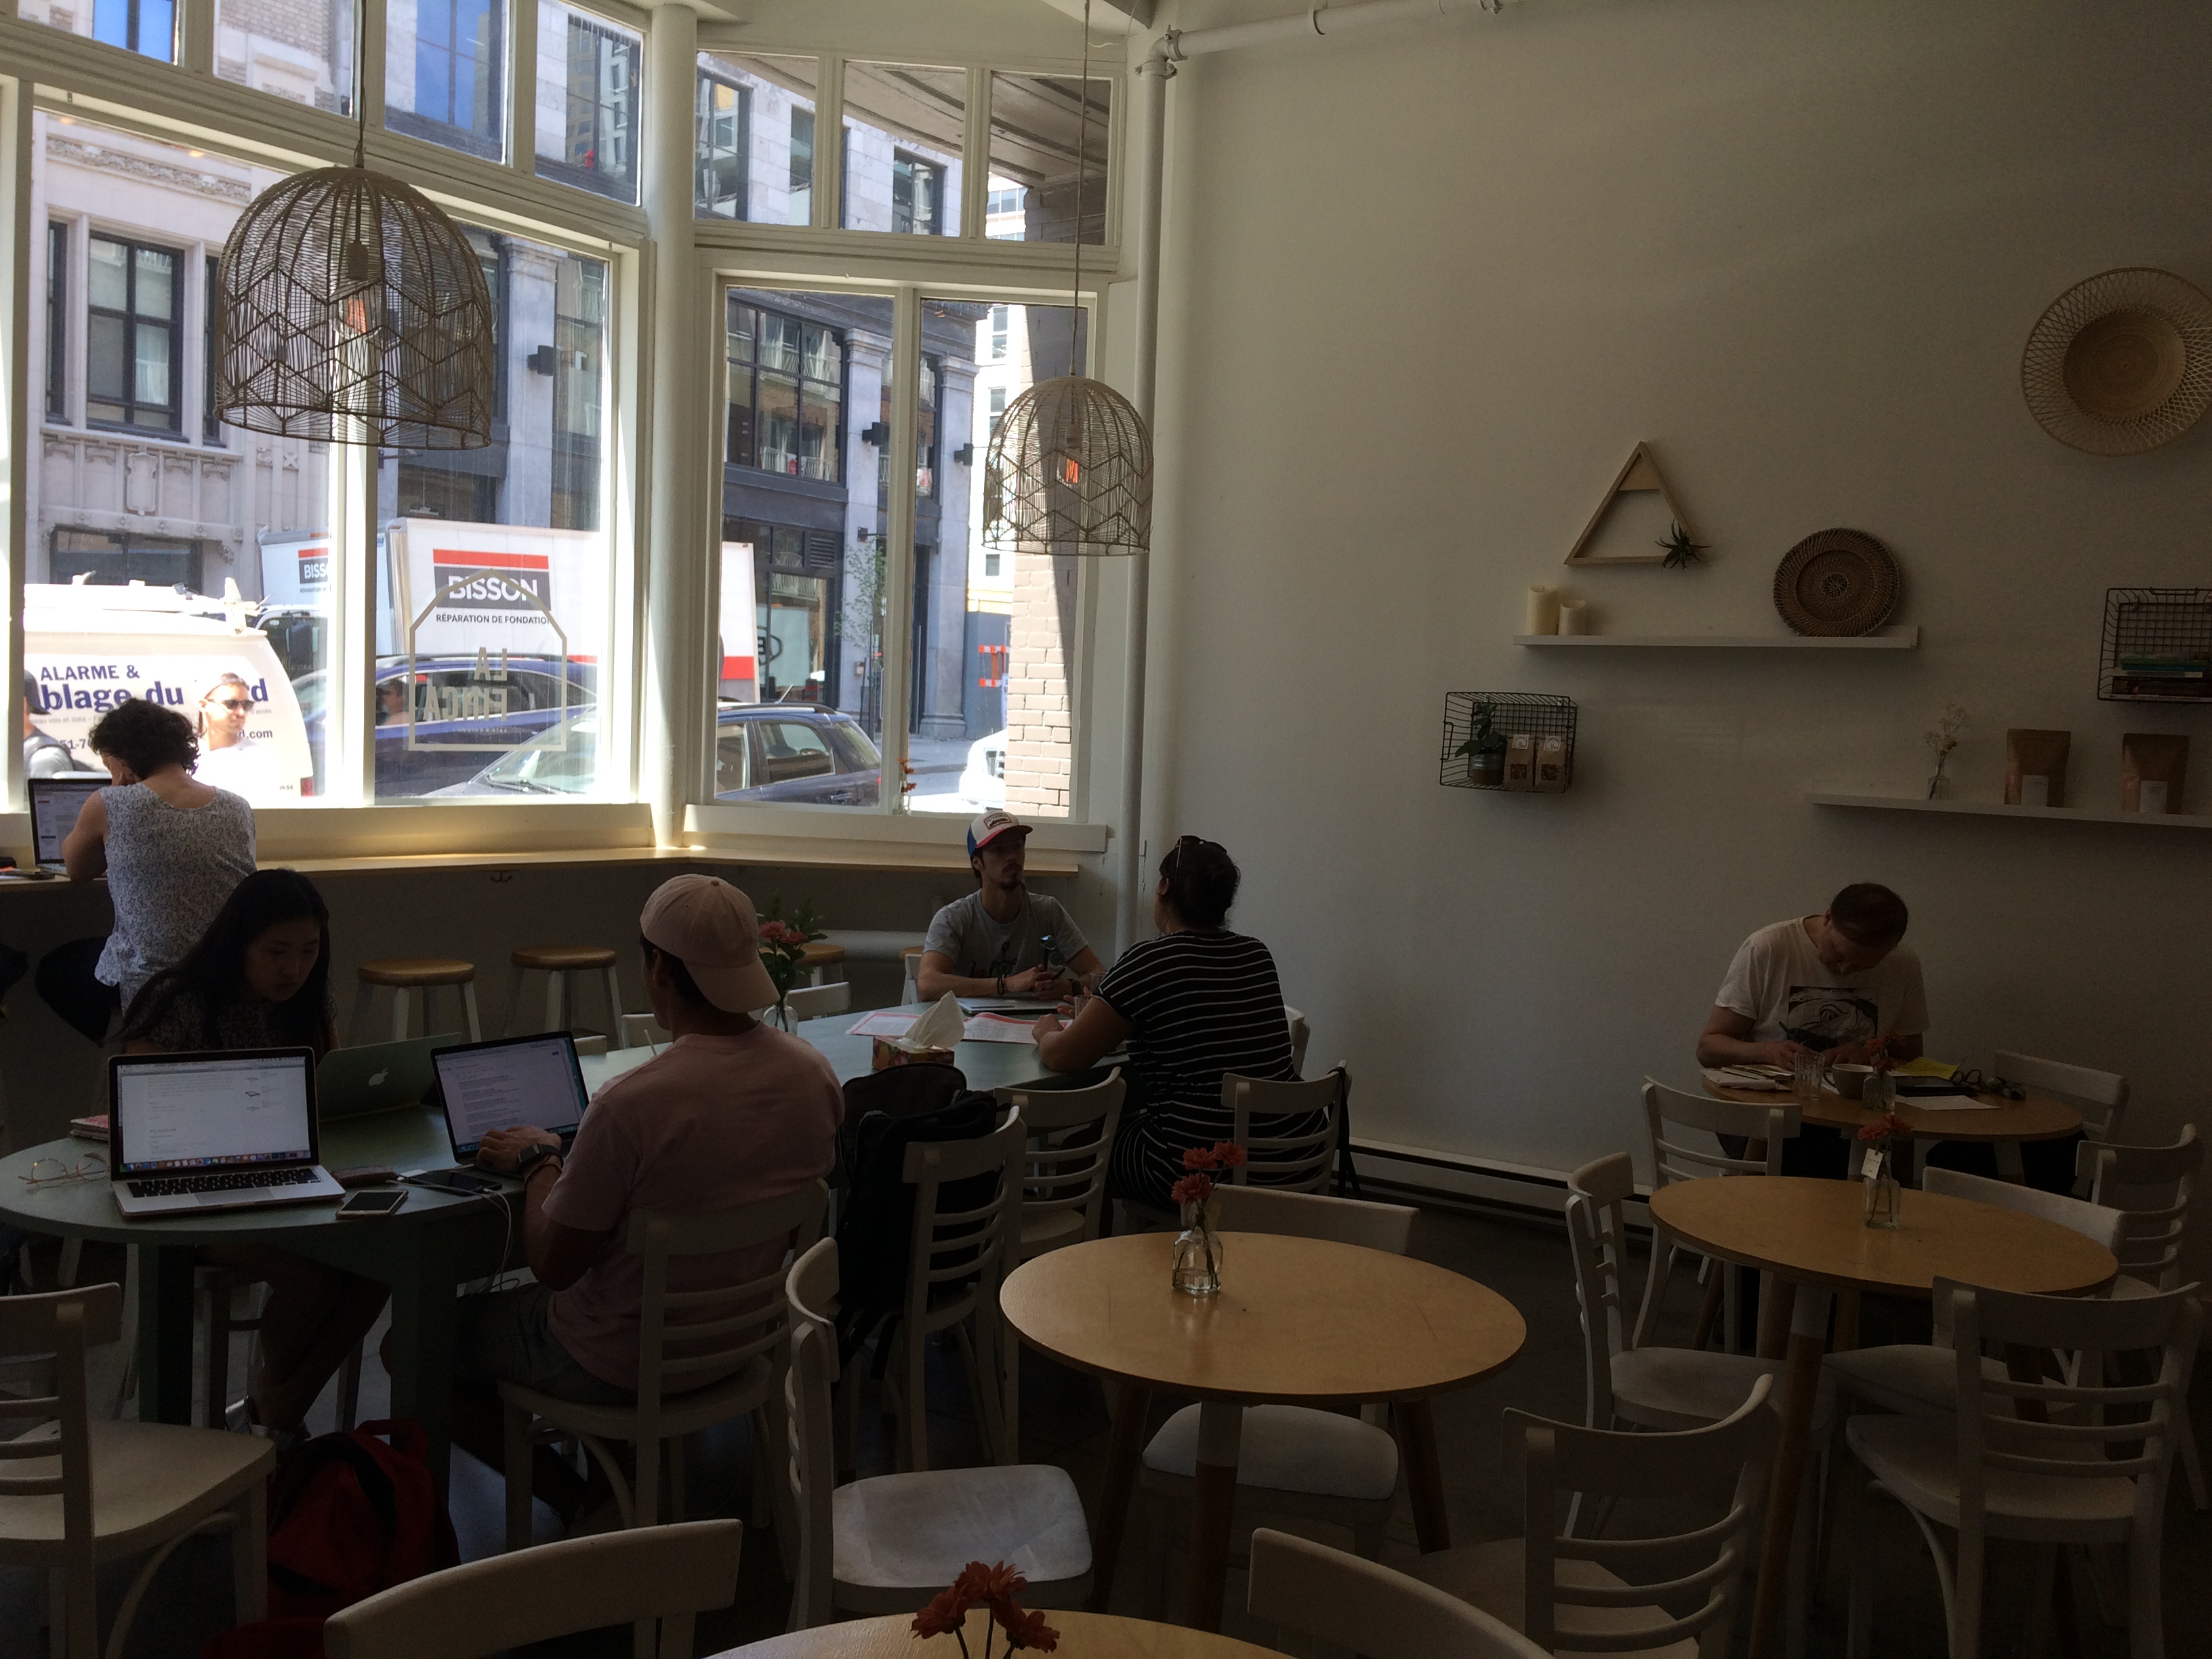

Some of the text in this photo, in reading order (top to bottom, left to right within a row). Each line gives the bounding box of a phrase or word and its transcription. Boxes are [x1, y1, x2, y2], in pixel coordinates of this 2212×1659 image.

[304, 563, 327, 579] BISS
[448, 575, 537, 602] BISSON
[436, 613, 490, 623] RÉPARATION
[491, 615, 503, 623] DE
[41, 664, 140, 680] ALARME &
[145, 680, 184, 705] du
